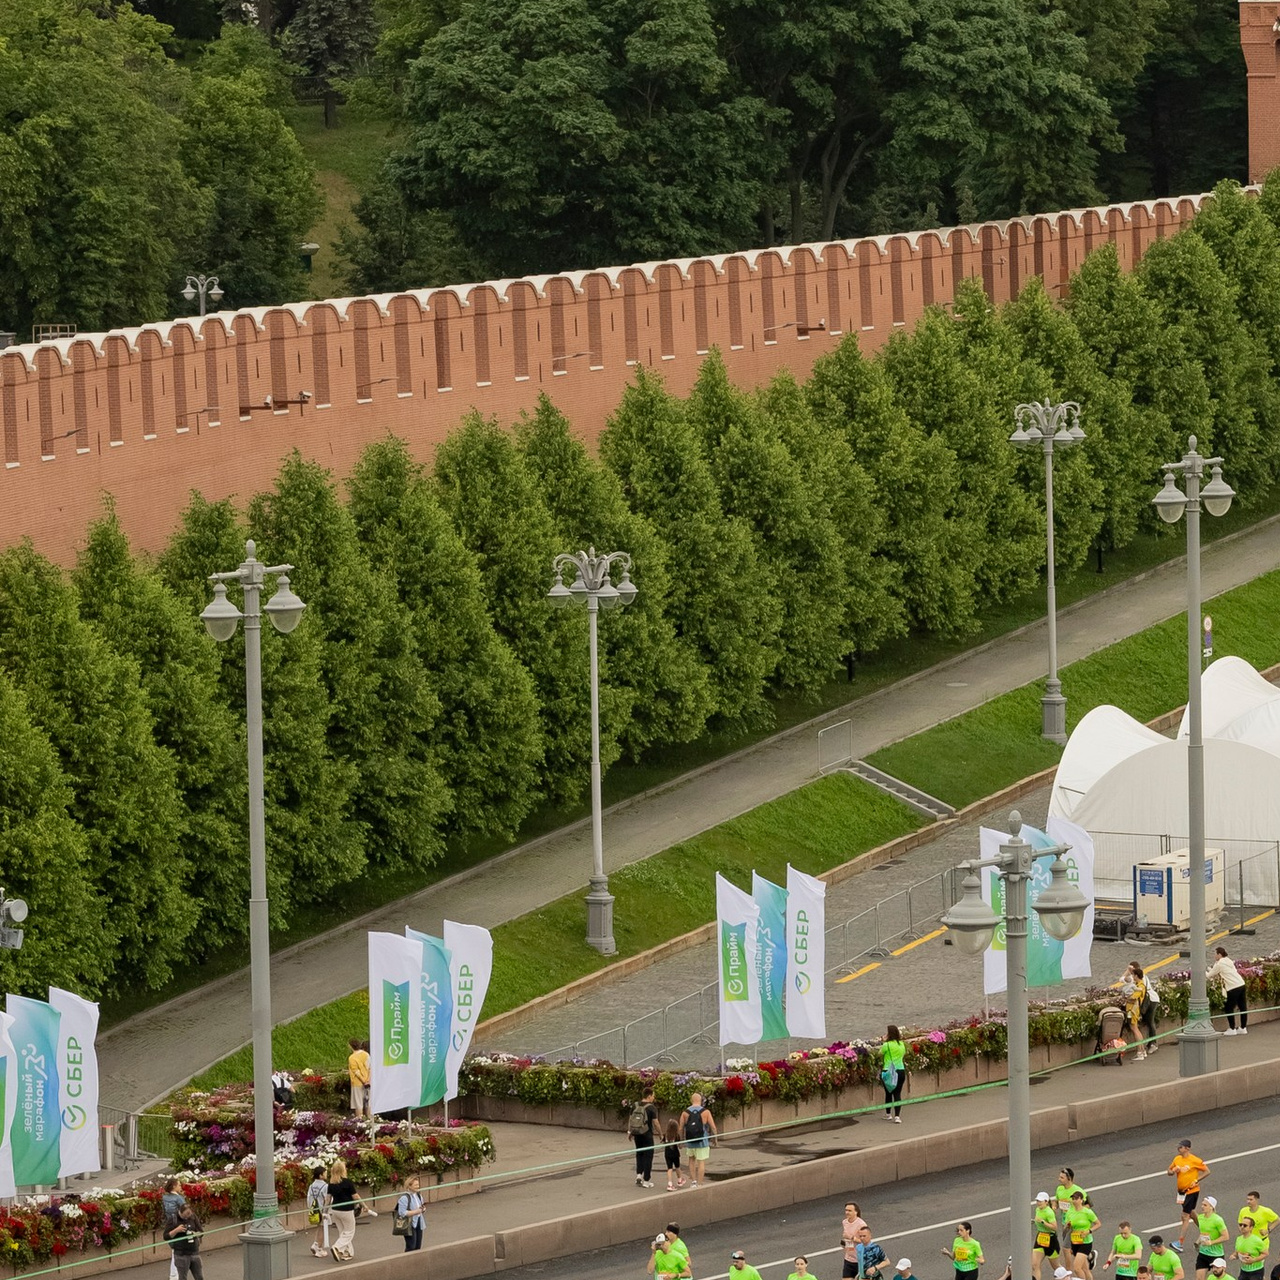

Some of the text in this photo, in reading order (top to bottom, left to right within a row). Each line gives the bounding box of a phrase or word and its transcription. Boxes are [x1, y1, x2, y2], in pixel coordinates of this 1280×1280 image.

[727, 932, 741, 976] Прайм
[795, 909, 809, 965] СБЕР
[390, 992, 404, 1040] Прайм
[457, 964, 474, 1023] СБЕР
[67, 1036, 83, 1098] СБЕР
[21, 1074, 33, 1133] зелёный
[35, 1080, 46, 1142] марафон
